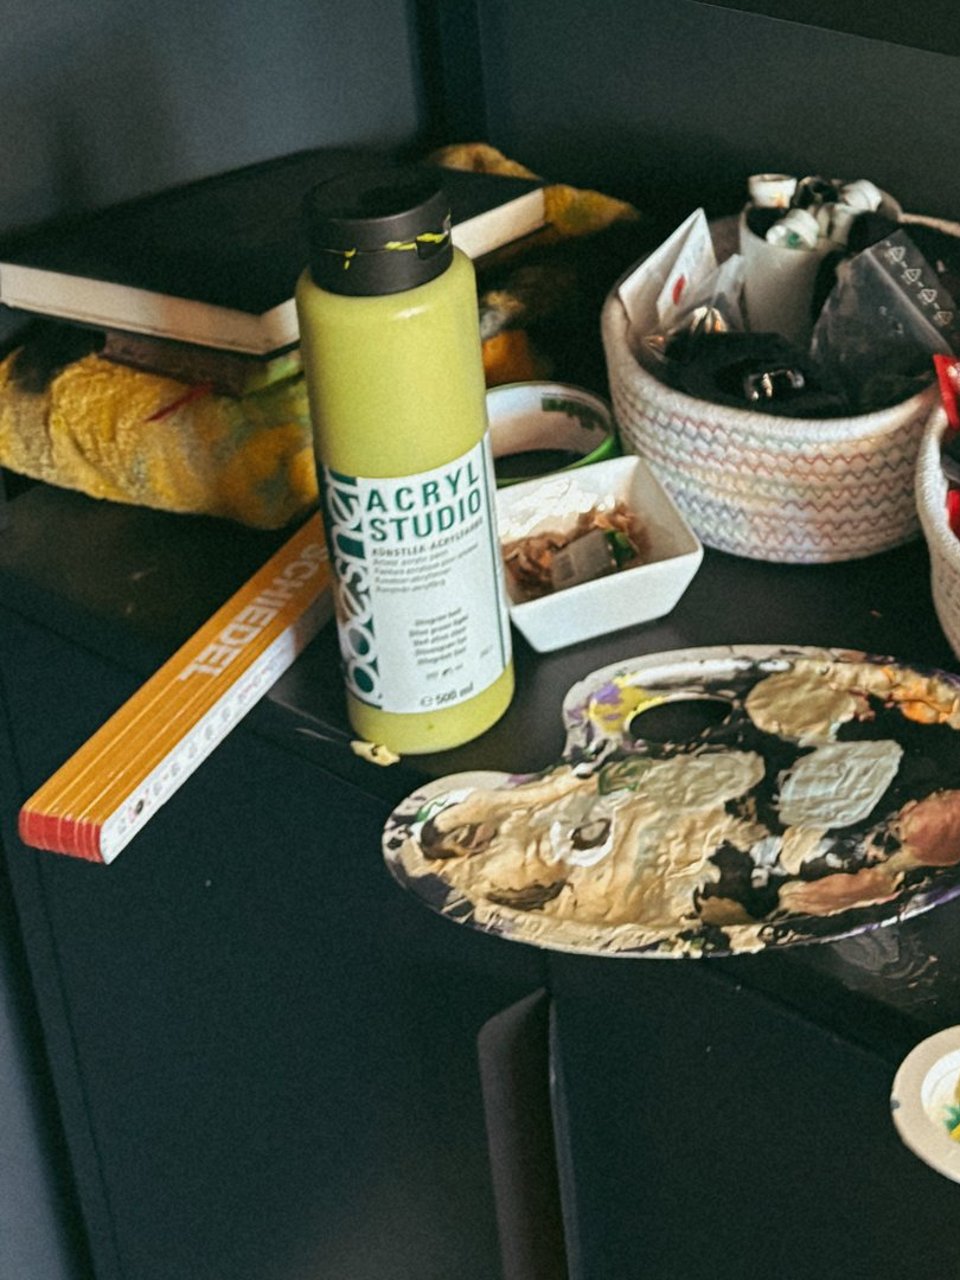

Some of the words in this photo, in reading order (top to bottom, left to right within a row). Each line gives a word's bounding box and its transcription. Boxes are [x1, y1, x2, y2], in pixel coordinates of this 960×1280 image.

[367, 461, 480, 513] ACRYL
[369, 488, 482, 543] STUDIO
[177, 543, 328, 682] SCHIEDEL
